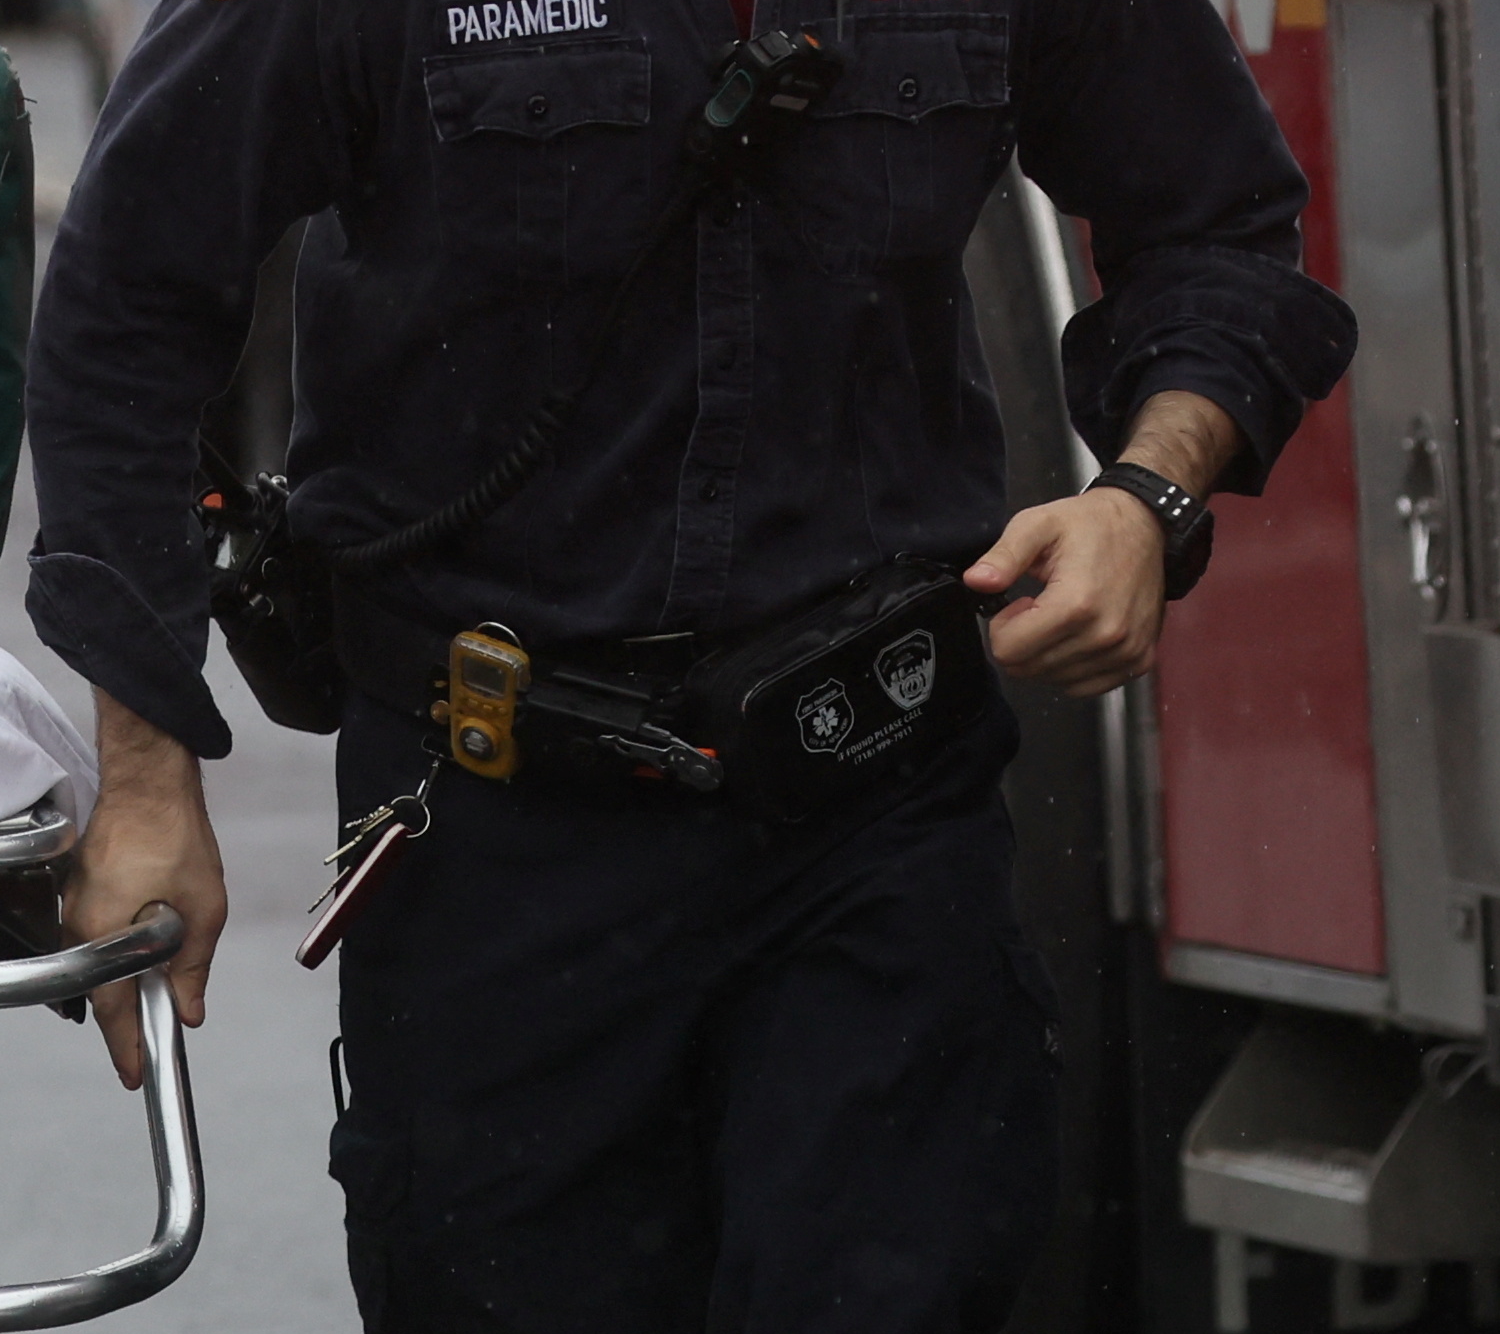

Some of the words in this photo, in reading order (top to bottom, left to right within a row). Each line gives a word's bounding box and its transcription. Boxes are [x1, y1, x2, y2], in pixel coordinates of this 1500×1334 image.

[837, 751, 845, 763] IF
[845, 736, 874, 758] FOUND
[874, 718, 904, 740] PLEASE
[904, 707, 924, 724] CALL
[853, 748, 877, 766] (718)
